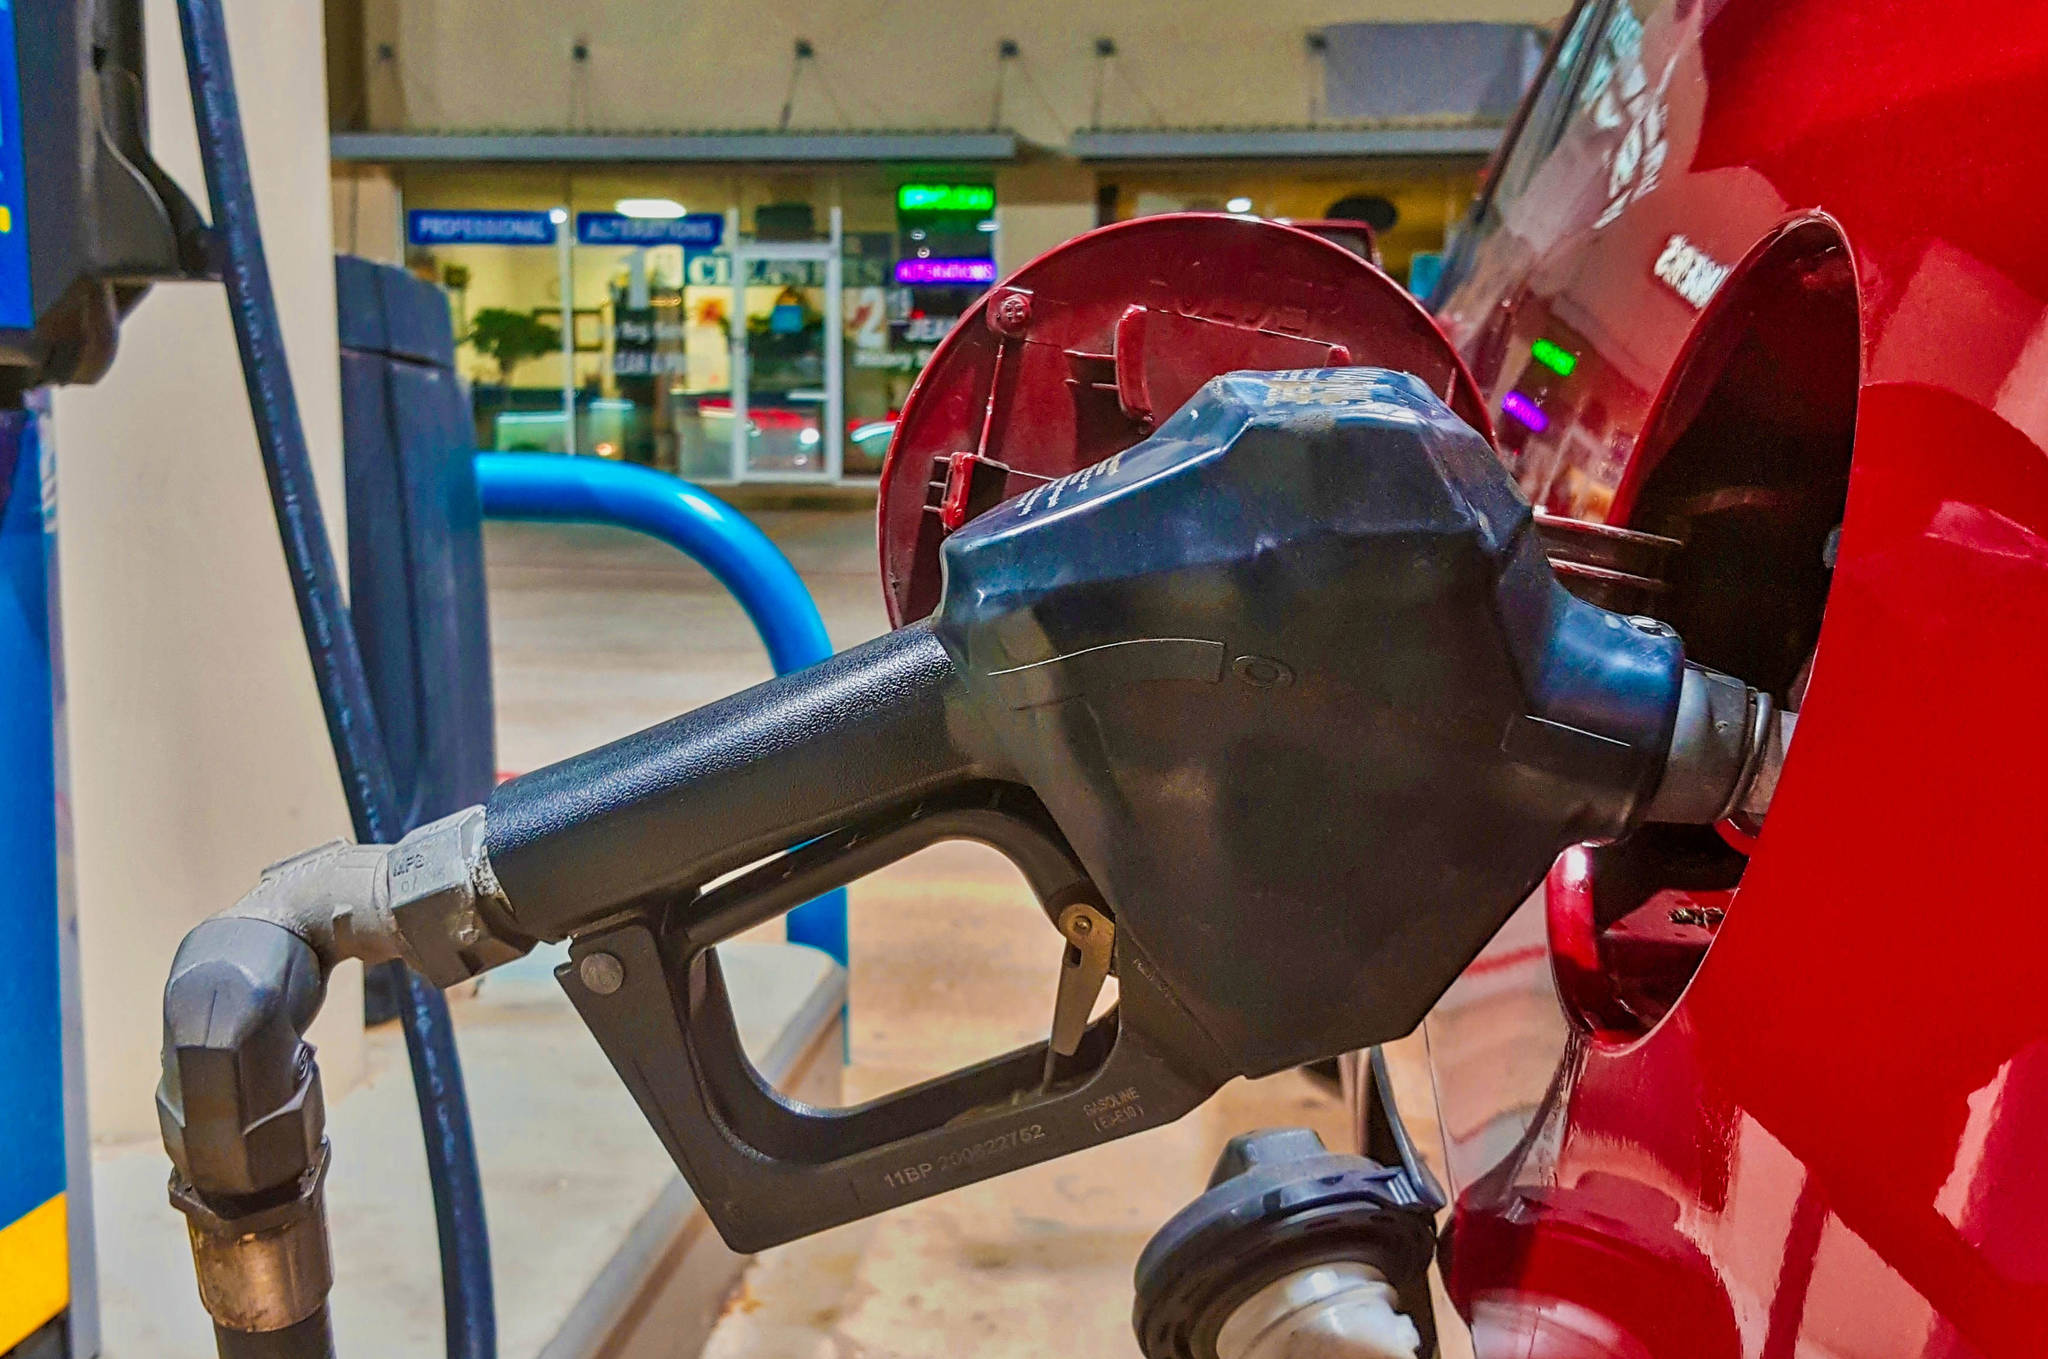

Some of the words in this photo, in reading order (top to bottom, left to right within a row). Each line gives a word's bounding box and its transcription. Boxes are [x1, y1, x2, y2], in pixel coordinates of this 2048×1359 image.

[418, 216, 547, 240] PROFESSIONAL
[588, 219, 713, 240] ALTERATIONS
[1082, 1086, 1141, 1117] GASOLINE
[883, 1162, 933, 1189] 11BP
